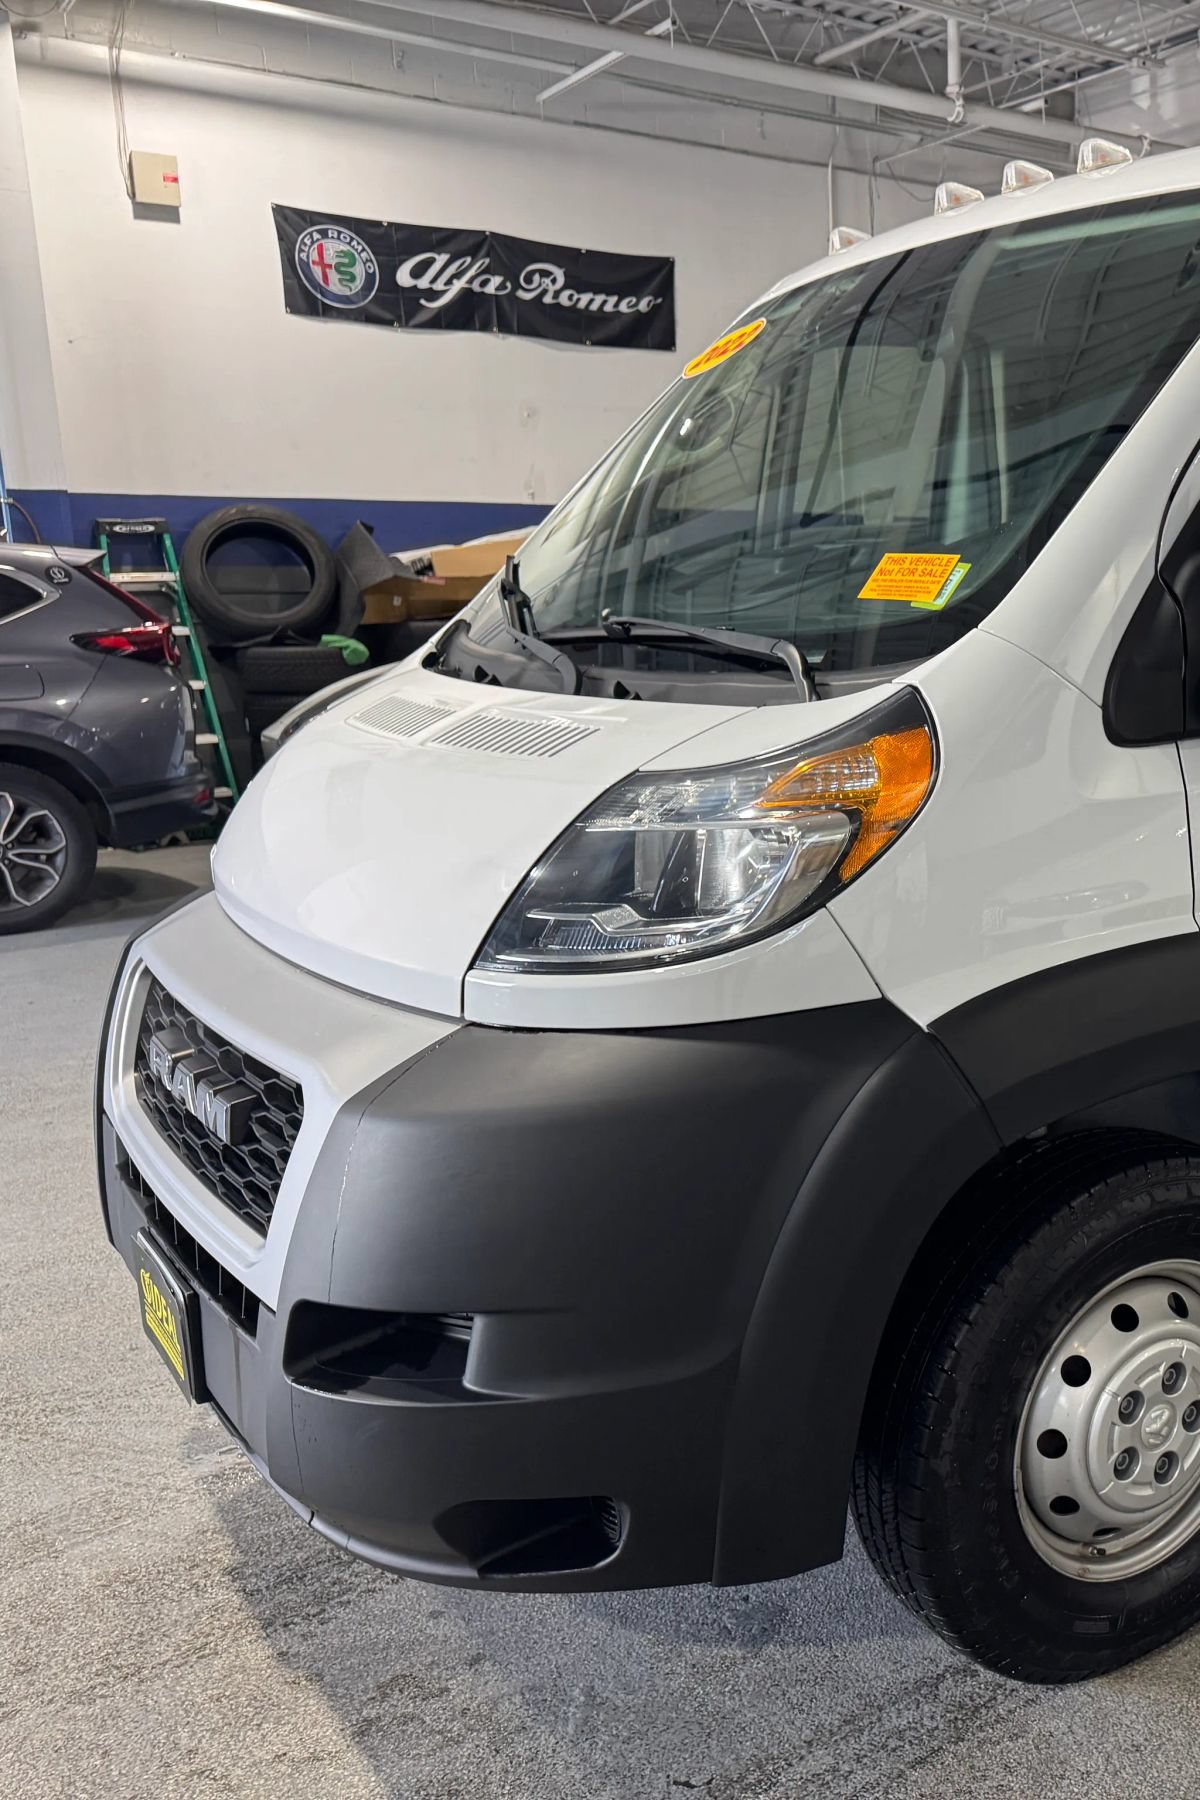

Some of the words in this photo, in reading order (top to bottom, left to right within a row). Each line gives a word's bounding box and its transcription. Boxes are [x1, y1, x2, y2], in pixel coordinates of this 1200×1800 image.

[299, 231, 322, 262] ALFA
[327, 229, 375, 274] ROMEO
[395, 251, 512, 309] Alfa
[515, 262, 662, 314] Romeo
[885, 556, 908, 567] THIS
[909, 557, 955, 568] VEHICLE
[895, 568, 918, 577] FOR
[919, 568, 949, 579] SALE
[150, 1031, 234, 1146] RAM
